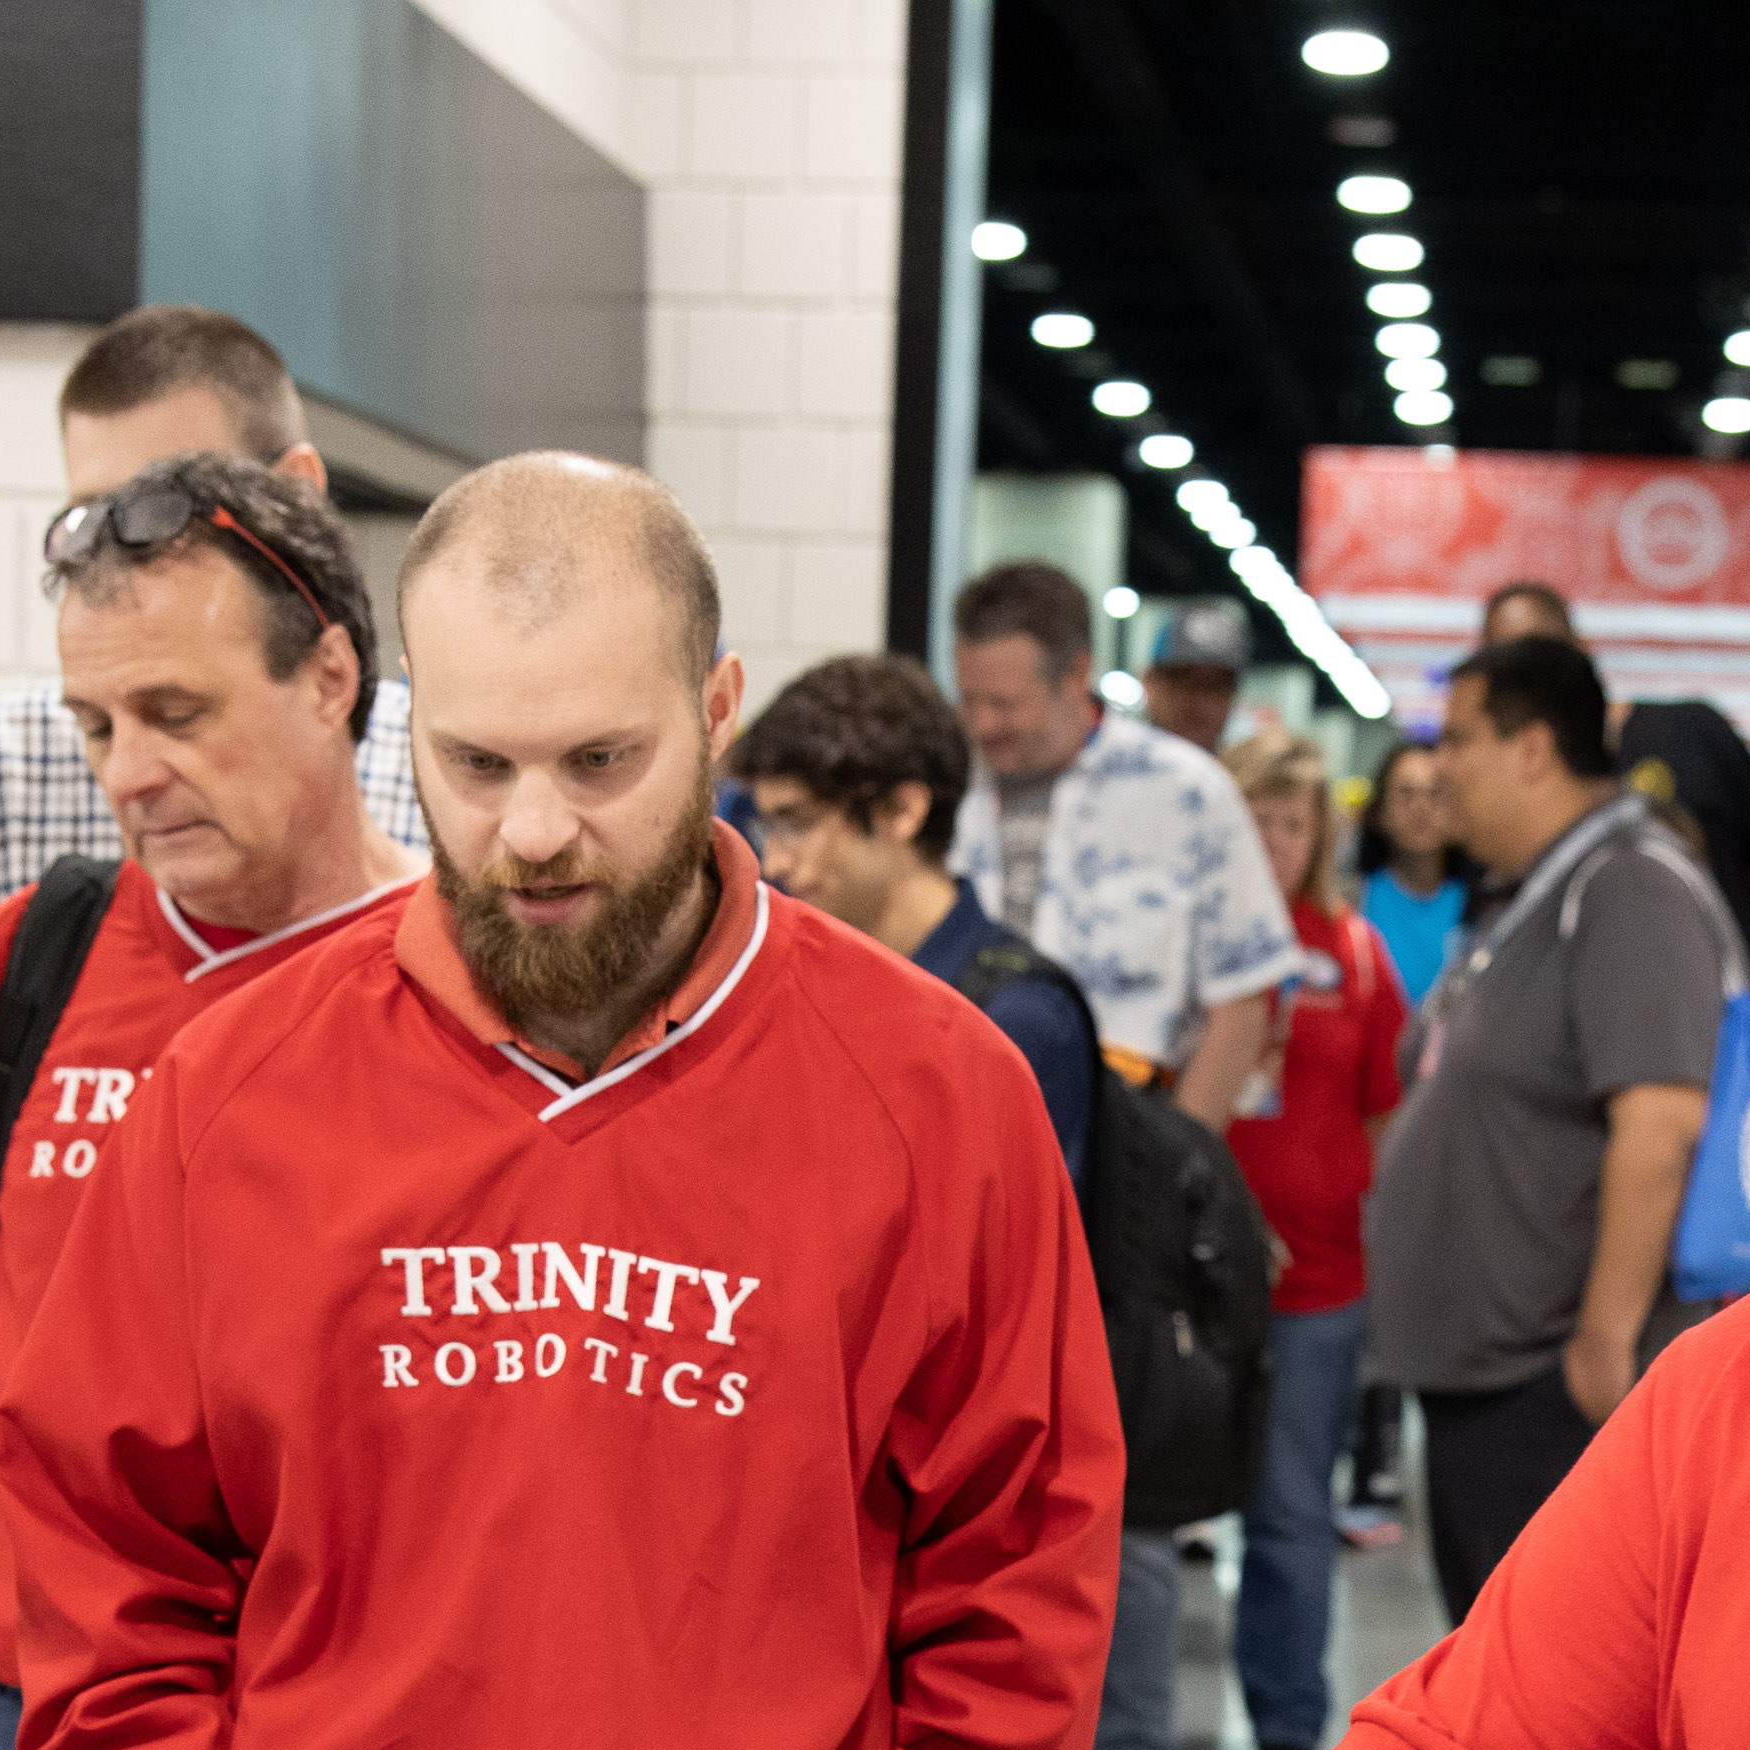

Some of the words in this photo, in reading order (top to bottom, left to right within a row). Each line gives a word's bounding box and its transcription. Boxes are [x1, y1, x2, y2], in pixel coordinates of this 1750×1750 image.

[52, 1066, 153, 1123] TR
[381, 1242, 760, 1346] TRINITY
[379, 1333, 748, 1417] ROBOTICS
